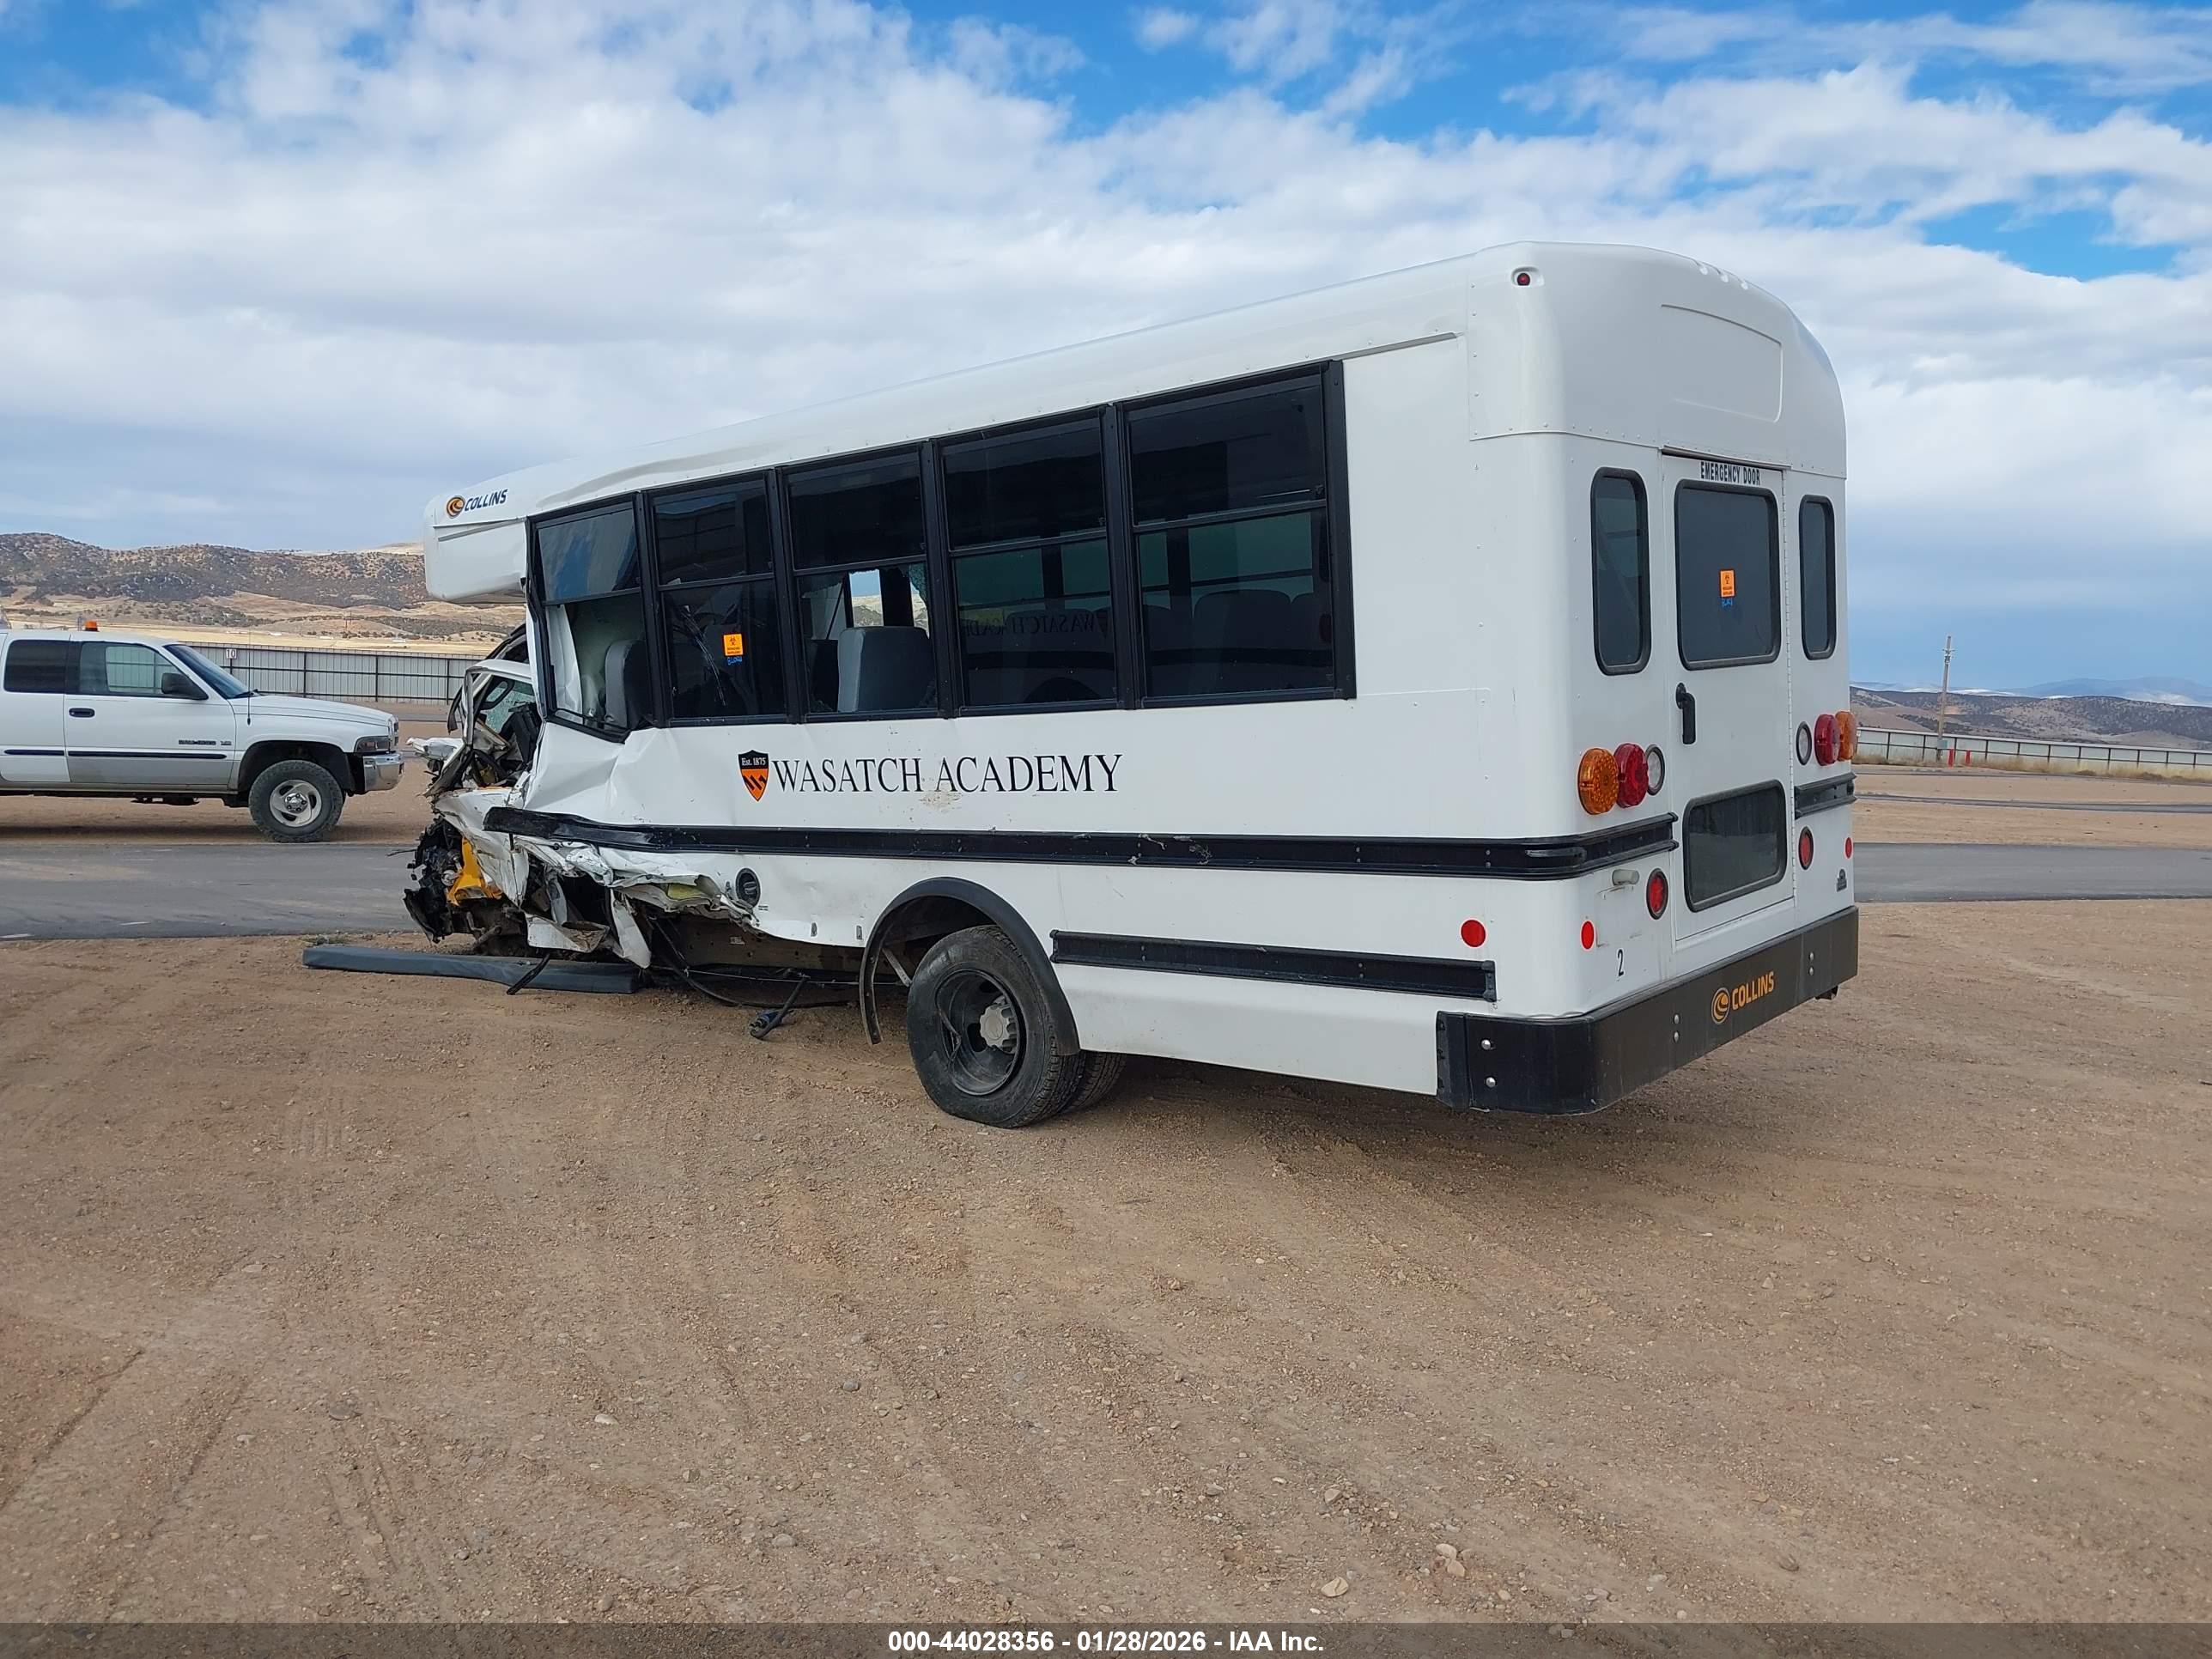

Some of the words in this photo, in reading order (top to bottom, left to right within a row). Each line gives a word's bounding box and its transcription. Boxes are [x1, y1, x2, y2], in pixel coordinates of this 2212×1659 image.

[1700, 461, 1741, 483] EMERGENCY
[1743, 466, 1760, 486] DOOR
[465, 489, 507, 512] COLLINS
[753, 757, 766, 766] 1875
[770, 757, 923, 793] WASATCH
[935, 754, 1123, 793] ACADEMY
[1617, 949, 1625, 977] 2
[1731, 971, 1775, 1011] COLLINS
